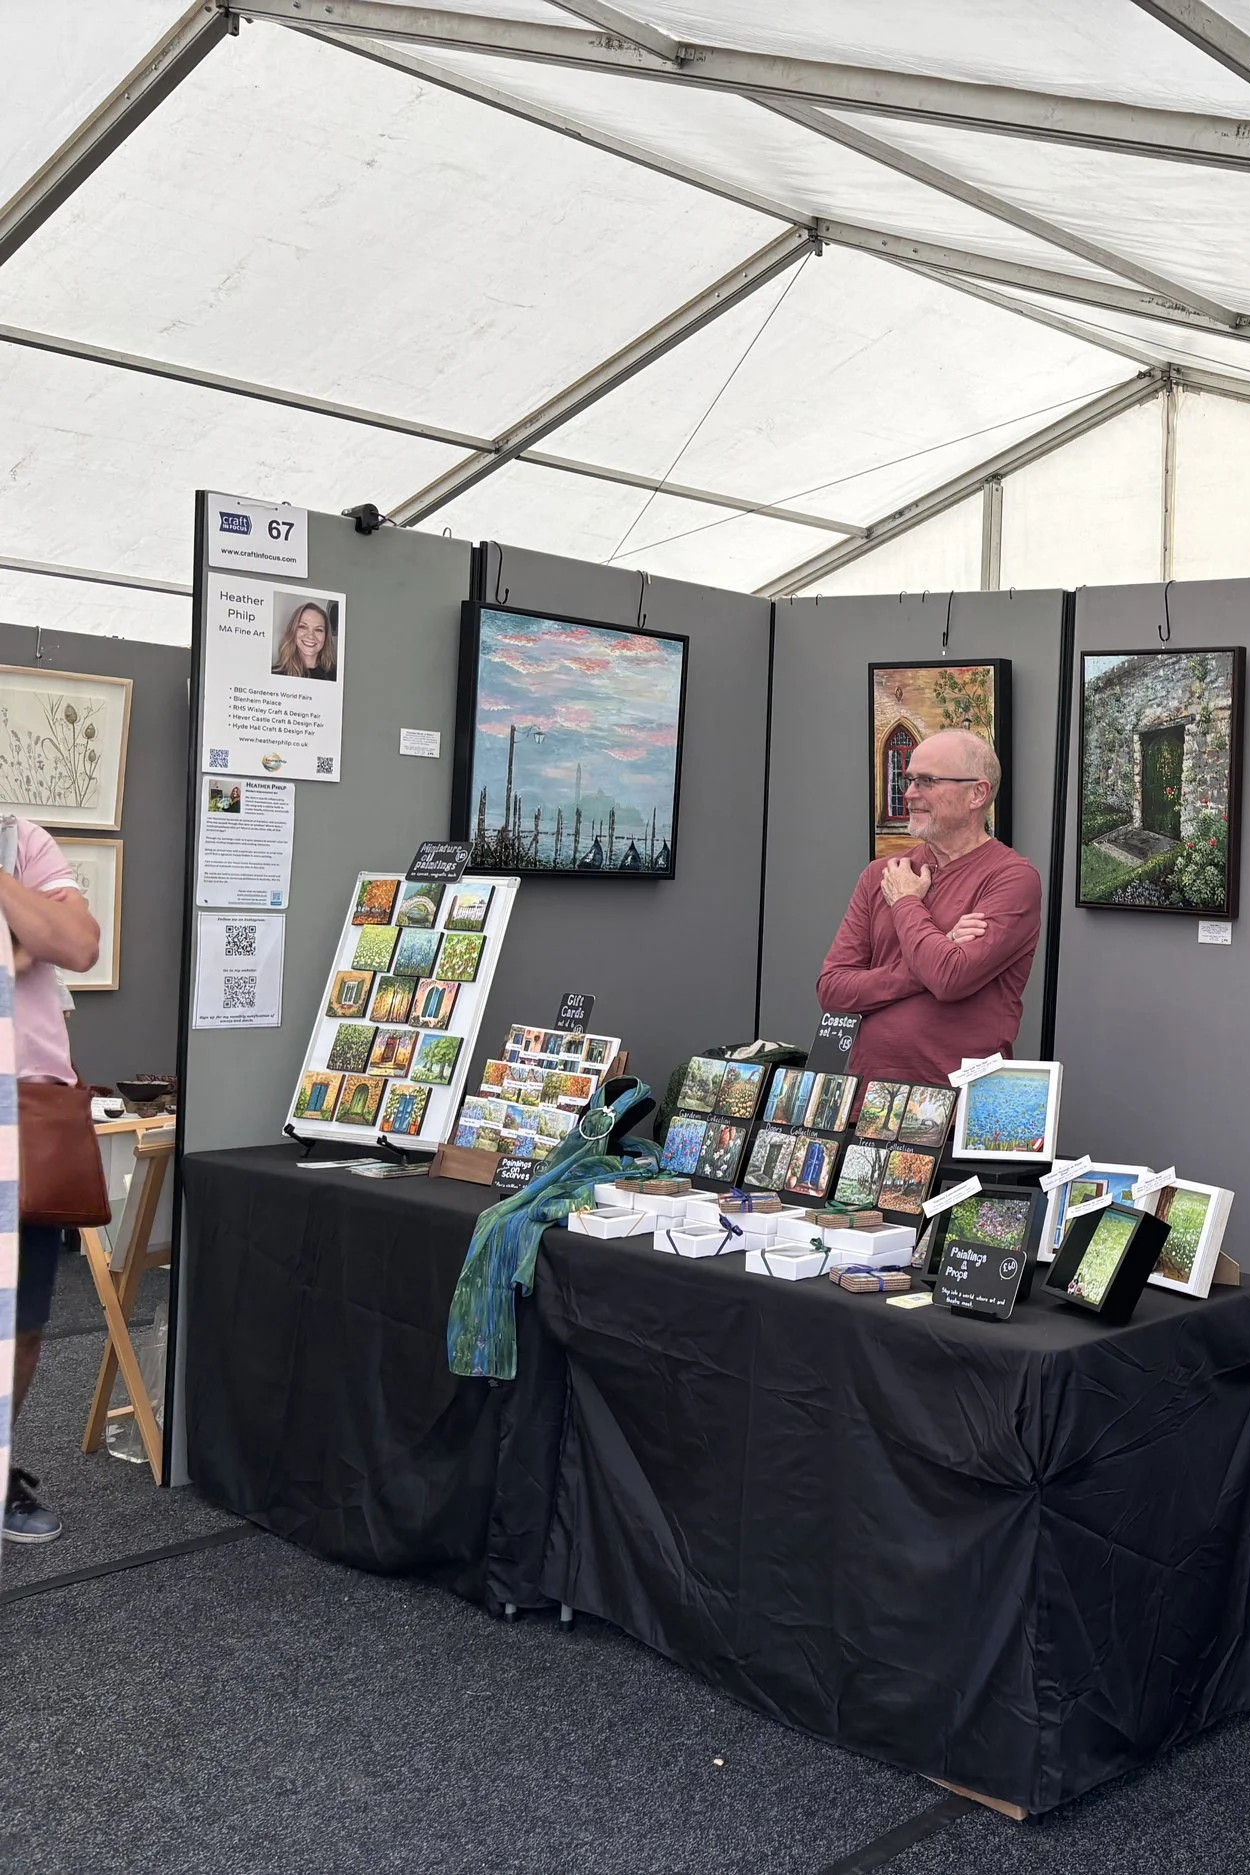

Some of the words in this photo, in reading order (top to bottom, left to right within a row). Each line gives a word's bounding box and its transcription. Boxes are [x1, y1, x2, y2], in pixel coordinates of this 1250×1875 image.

[222, 516, 248, 527] craft
[268, 520, 295, 541] 67
[221, 548, 297, 563] www.craftinfocus.com
[220, 590, 264, 606] Heather
[228, 609, 256, 622] Philp
[219, 624, 232, 632] MA
[235, 627, 251, 635] Fine
[249, 688, 279, 697] Gardeners
[247, 706, 267, 714] Wisley
[239, 737, 308, 747] www.heatherphilp.co.uk
[420, 843, 462, 853] Miniature
[421, 851, 435, 861] oil
[414, 860, 457, 871] paintings
[568, 994, 585, 1006] Gift
[561, 1006, 585, 1018] Cards
[822, 1013, 857, 1027] Coaster
[765, 1122, 782, 1133] Doors
[790, 1126, 818, 1137] Collection
[859, 1137, 875, 1148] Trees
[885, 1141, 914, 1153] Collection
[502, 1158, 532, 1170] Paintings
[501, 1171, 530, 1181] Scarves
[950, 1246, 987, 1267] Paintings
[1003, 1261, 1016, 1272] £60
[945, 1266, 968, 1282] Props
